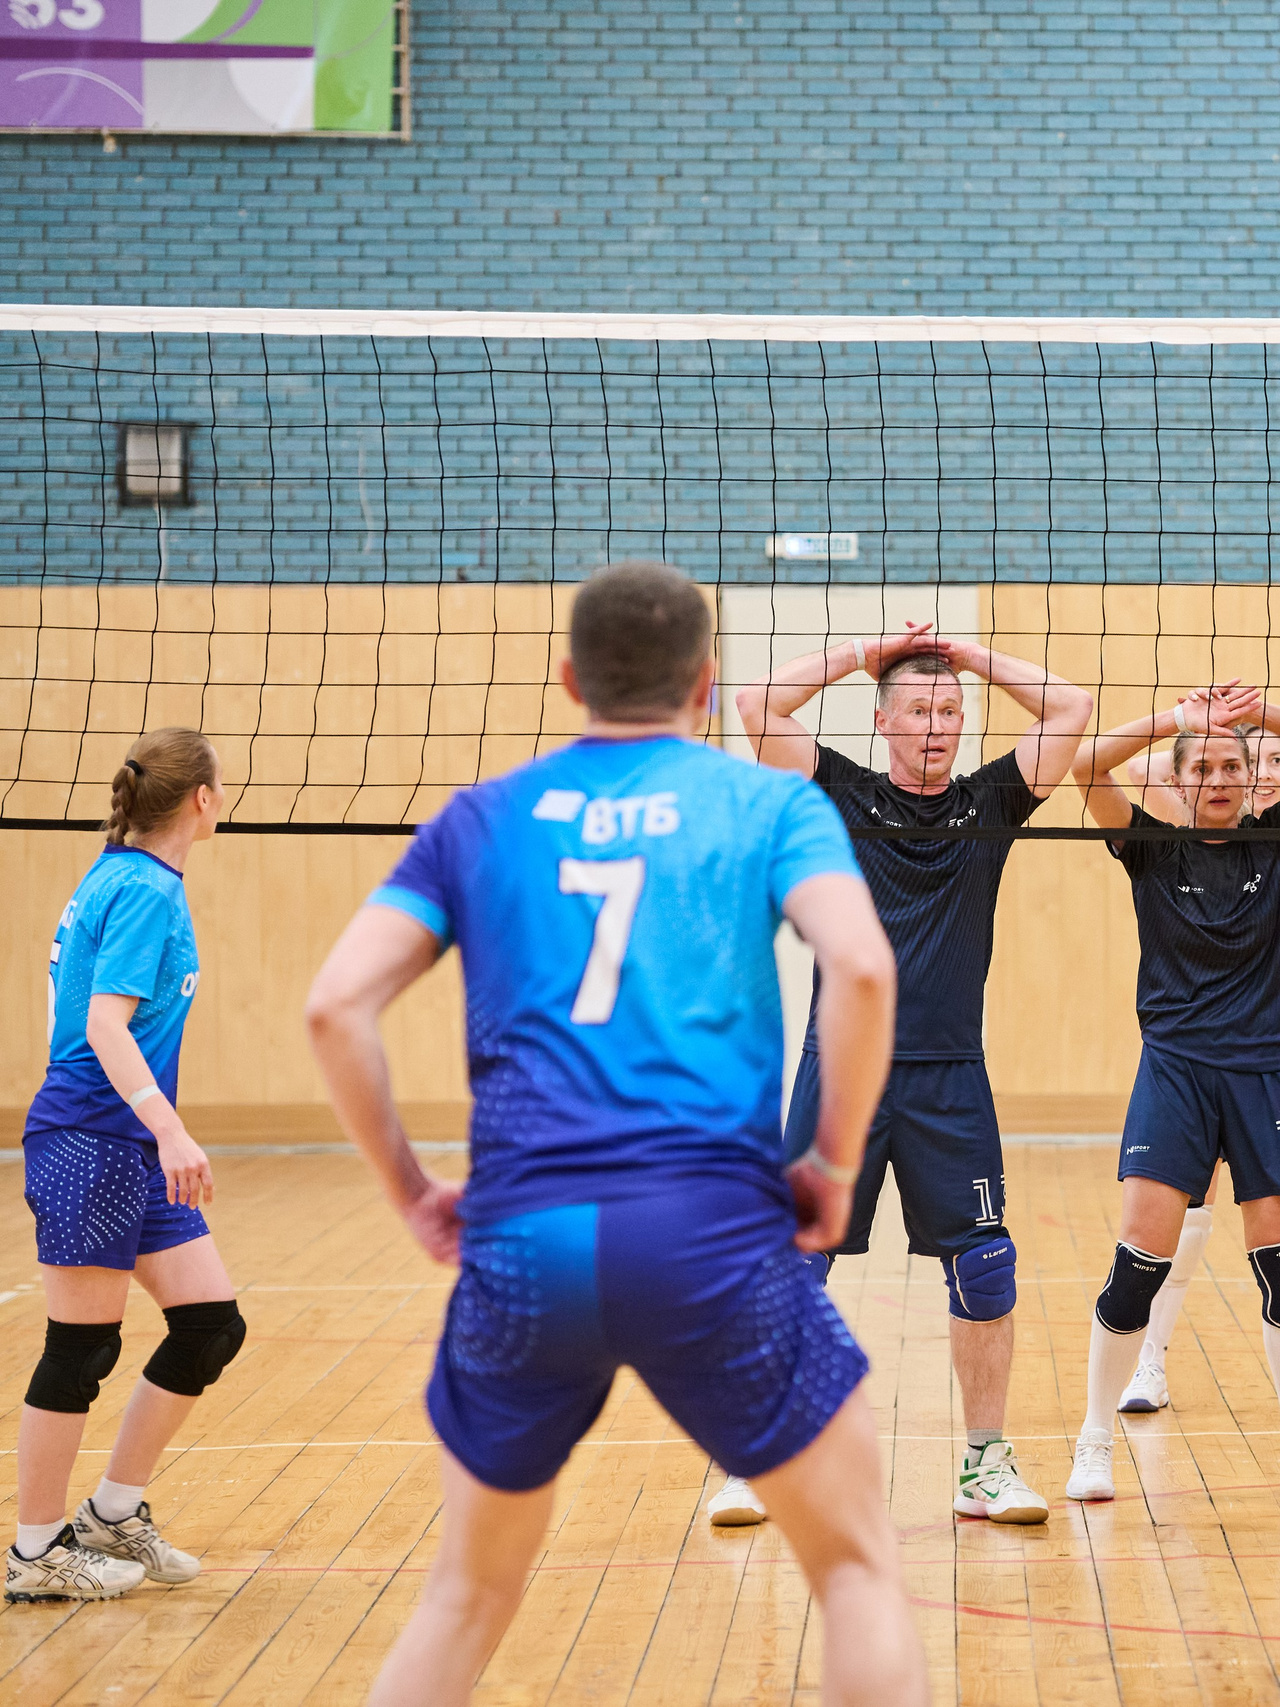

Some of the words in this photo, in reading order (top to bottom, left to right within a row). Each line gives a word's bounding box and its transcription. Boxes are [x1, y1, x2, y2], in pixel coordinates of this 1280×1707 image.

[581, 791, 681, 844] ВТБ
[558, 855, 645, 1025] 7
[972, 1174, 1007, 1227] 1
